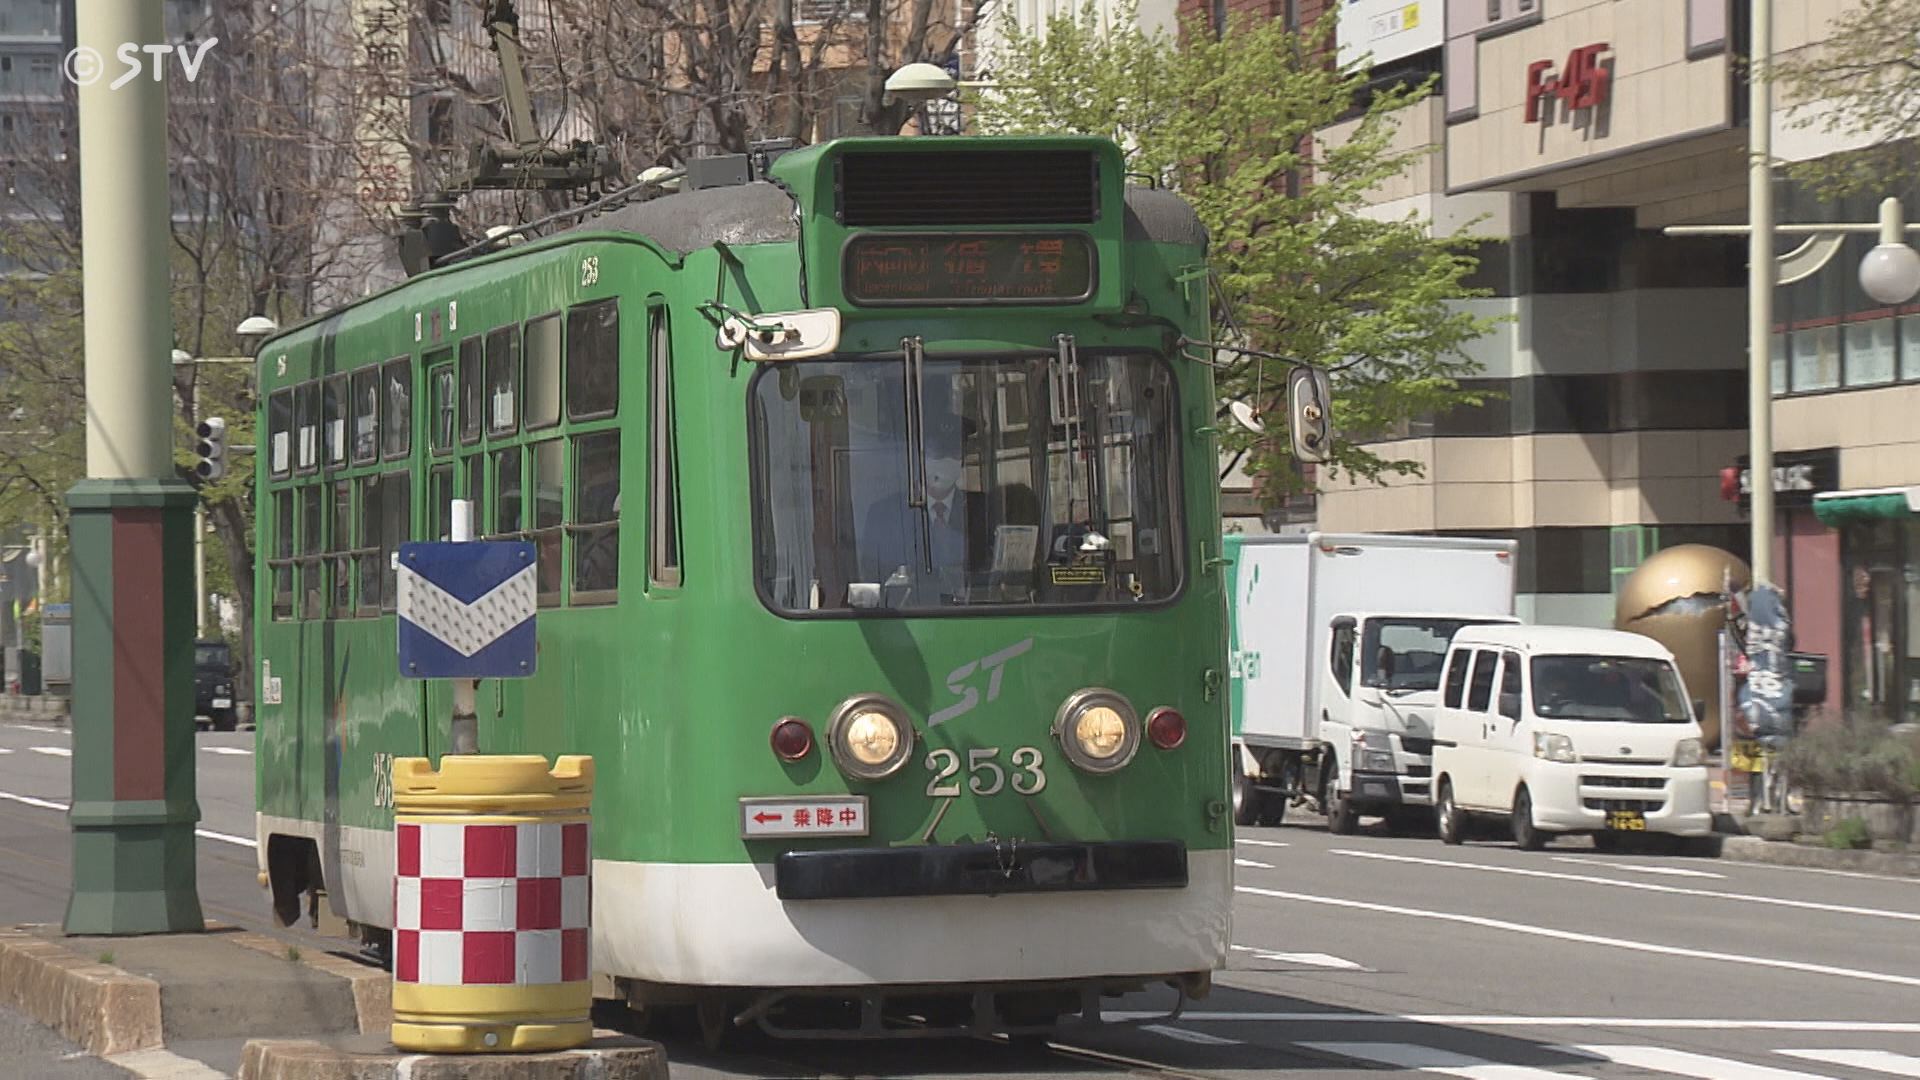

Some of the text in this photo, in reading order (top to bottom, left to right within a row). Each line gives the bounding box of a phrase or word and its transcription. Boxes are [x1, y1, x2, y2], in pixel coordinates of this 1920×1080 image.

[581, 256, 599, 288] 253
[928, 638, 1034, 728] ST
[373, 752, 395, 808] 253
[925, 746, 1046, 796] 253
[793, 807, 857, 827] 乗降中
